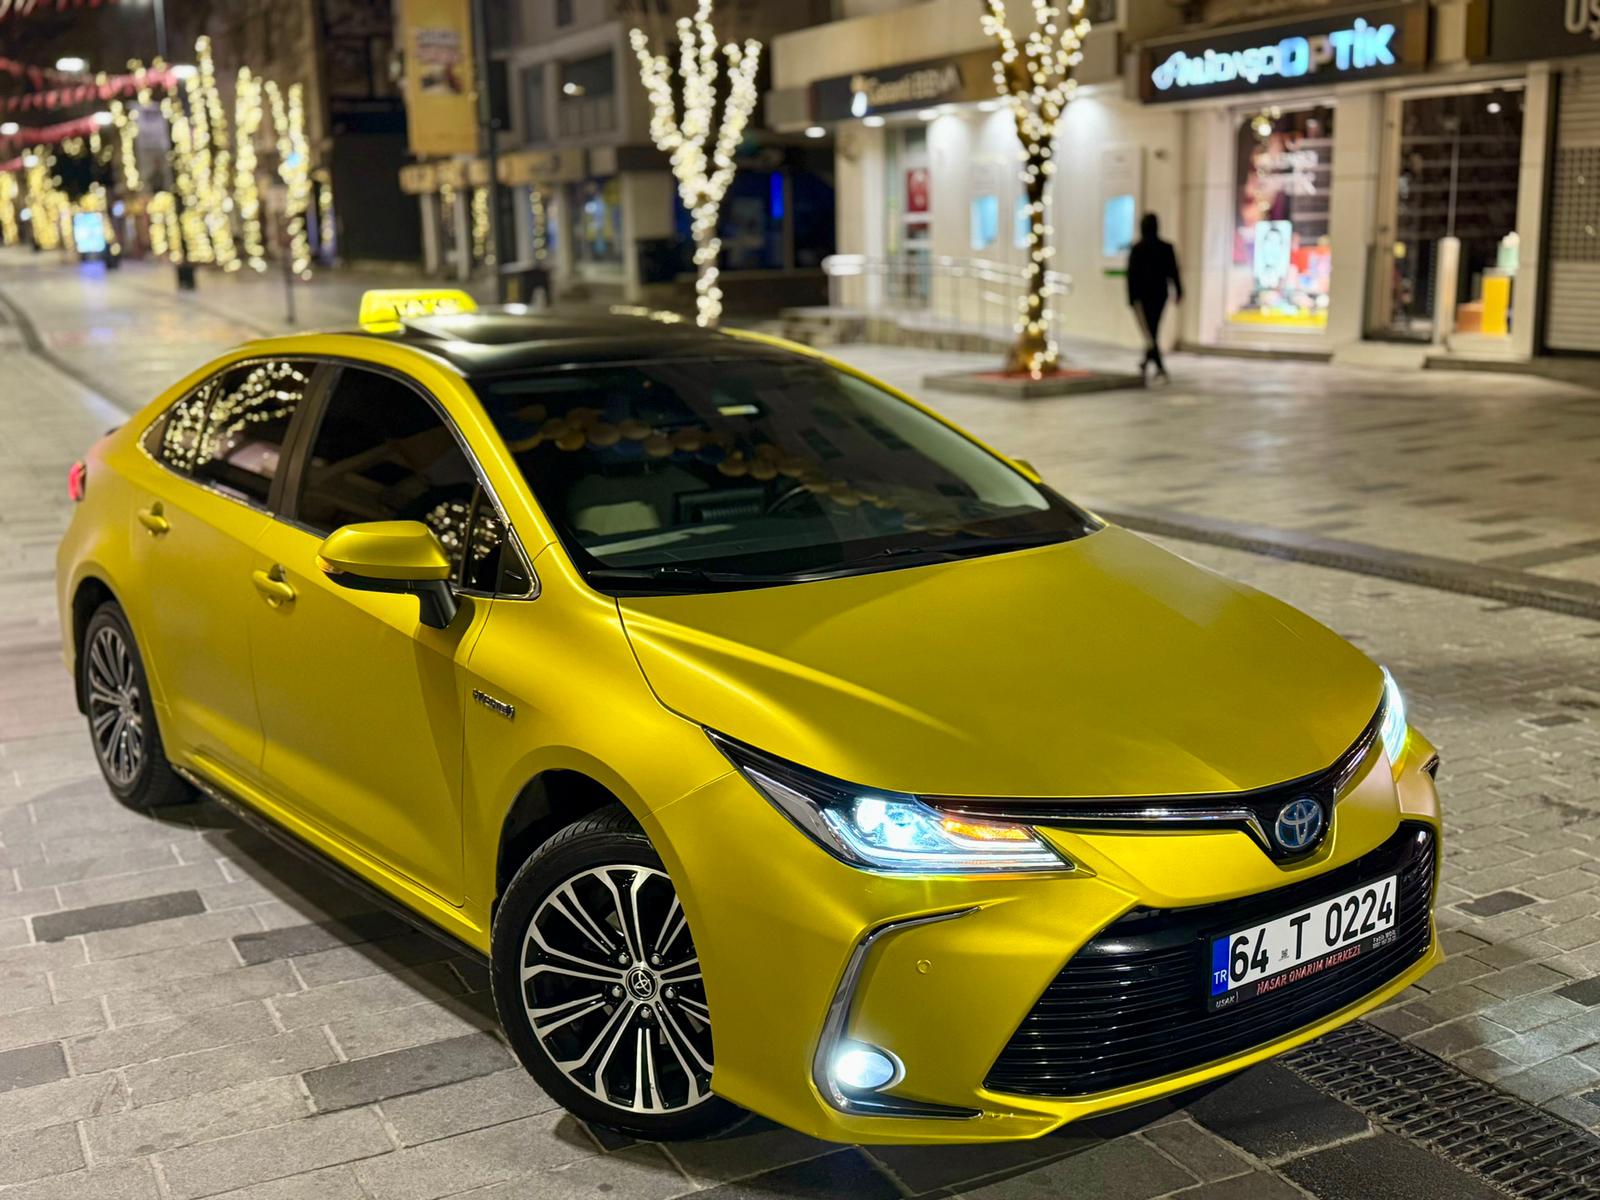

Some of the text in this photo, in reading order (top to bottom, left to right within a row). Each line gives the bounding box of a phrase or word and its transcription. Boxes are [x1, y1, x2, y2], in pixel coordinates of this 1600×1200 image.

[1230, 881, 1393, 983] 64 T 0224
[1213, 969, 1228, 985] TR
[1256, 973, 1288, 996] HASAR
